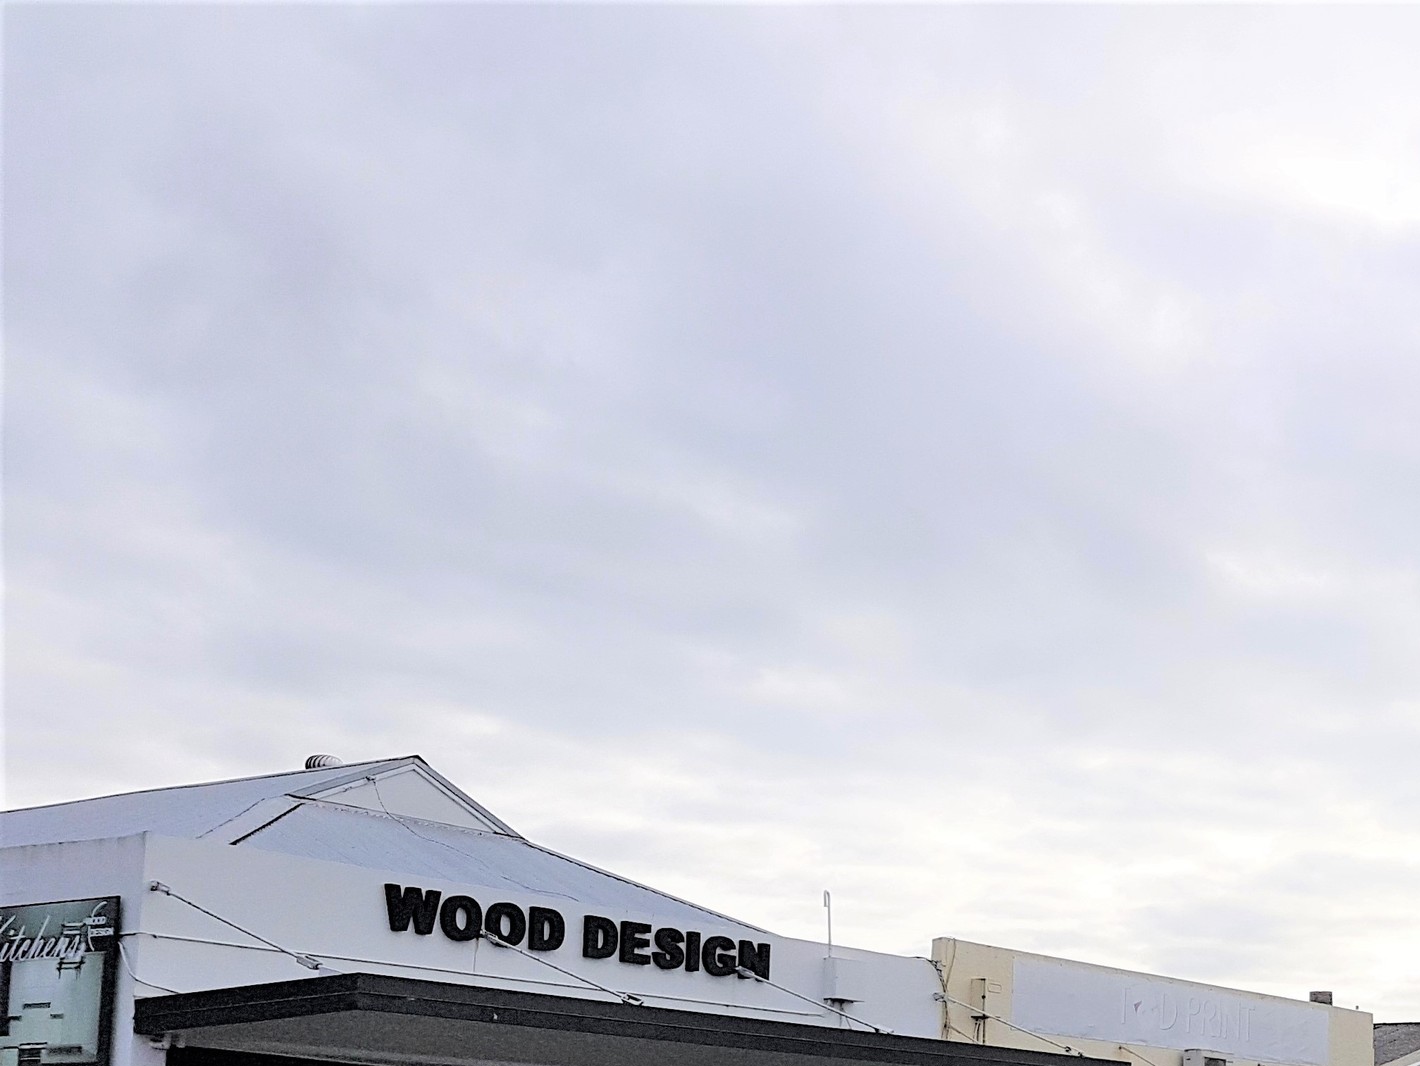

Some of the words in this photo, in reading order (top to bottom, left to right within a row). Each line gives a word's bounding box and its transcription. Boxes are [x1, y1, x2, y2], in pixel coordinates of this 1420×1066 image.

[0, 914, 85, 962] itchens
[384, 883, 565, 952] WOOD
[582, 915, 771, 981] DESIGN
